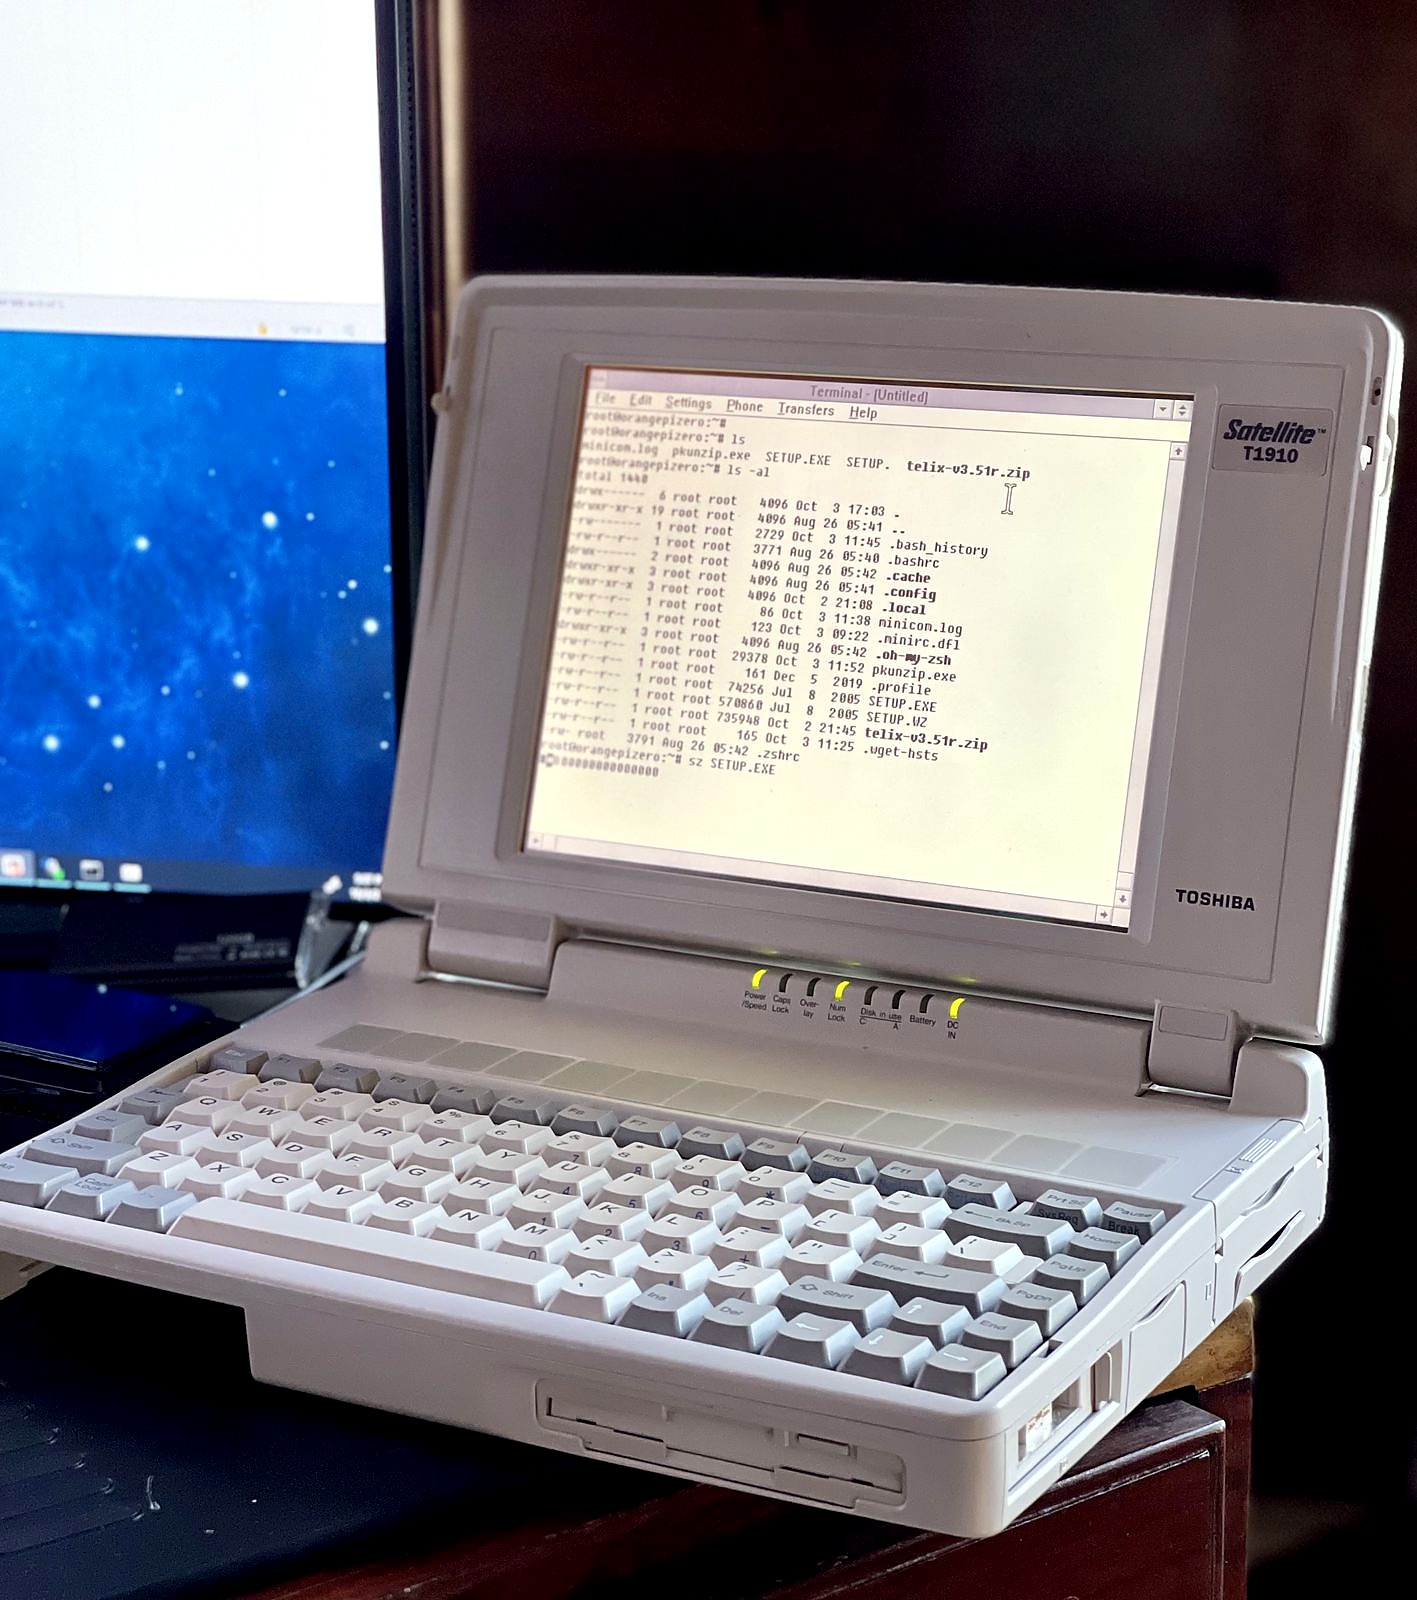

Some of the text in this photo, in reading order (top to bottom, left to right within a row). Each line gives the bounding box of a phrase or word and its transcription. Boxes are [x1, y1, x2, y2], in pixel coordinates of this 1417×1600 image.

[811, 385, 929, 406] Terminal [Untitled]
[594, 392, 878, 422] File Edit Settings Phone Transfers Help
[1223, 419, 1316, 444] Satellite
[731, 434, 745, 445] ls
[671, 445, 751, 460] pkunzip.exe
[765, 451, 831, 466] SETUP.EXE
[845, 456, 888, 470] SETUP.
[1243, 445, 1299, 463] T1910
[727, 464, 741, 475] ls
[749, 466, 771, 477] -al
[759, 497, 885, 517] 4096 Oct 17:03
[757, 512, 883, 532] 4096 Aug 05:41
[754, 528, 988, 558] 2729 Oct 11:45 .bash_history
[752, 543, 939, 569] 3771 Aug 05:40 .bashrc
[750, 558, 930, 584] 4096 Aug 05:42 .cache
[748, 574, 935, 602] 4096 Aug 05:41 .config
[746, 589, 926, 615] 4096 Oct 21:08 .local
[759, 606, 962, 637] 86 Oct 11:38 minicom.log
[750, 620, 961, 651] 123 Oct 09:22 .minirc.dfl
[740, 635, 770, 648] 4096
[777, 639, 799, 653] Aug
[829, 643, 867, 658] 05:42
[731, 650, 956, 682] 29378 Oct 11:52 pkunzip.exe
[743, 667, 931, 696] 161 Dec 2019 .profile
[727, 681, 937, 713] 74256 Jul 2005 SETUP.EXE
[718, 695, 927, 728] 570860 Jul 2005 SETUP.WZ
[716, 711, 760, 726] 735948
[767, 716, 789, 729] Oct
[818, 722, 857, 736] 21:45
[626, 732, 800, 762] 3791 Aug 05:42 .zshrc
[735, 729, 938, 762] 165 Oct 11:25 .wget-hsts
[688, 757, 703, 767] sz
[709, 757, 776, 775] SETUP.EXE
[1175, 888, 1255, 911] TOSHIBA
[744, 991, 767, 1001] Power
[773, 994, 791, 1005] Caps
[741, 1001, 767, 1011] /Speed
[772, 1004, 789, 1014] Lock
[800, 999, 820, 1009] Over-
[829, 1003, 847, 1013] Num
[803, 1009, 814, 1020] lay
[827, 1013, 846, 1023] Lock
[860, 1007, 877, 1017] Disk
[888, 1013, 902, 1021] use
[859, 1017, 866, 1026] C
[909, 1015, 937, 1027] Battery
[947, 1020, 959, 1030] DC
[948, 1031, 957, 1039] IN
[200, 1096, 217, 1106] Q
[258, 1107, 280, 1116] W
[315, 1117, 333, 1126] E
[166, 1123, 182, 1132] A
[374, 1129, 392, 1137] R
[226, 1133, 244, 1143] S
[438, 1139, 454, 1147] T
[285, 1144, 303, 1152] D
[149, 1153, 169, 1161] Z
[345, 1155, 364, 1163] F
[501, 1151, 517, 1159] Y
[209, 1164, 229, 1172] X
[409, 1168, 426, 1177] G
[561, 1163, 579, 1171] U
[271, 1176, 289, 1184] C
[470, 1179, 490, 1189] H
[336, 1187, 353, 1196] V
[534, 1192, 551, 1200] J
[690, 1188, 708, 1196] O
[395, 1199, 414, 1208] B
[600, 1204, 620, 1214] K
[756, 1200, 775, 1208] P
[459, 1211, 480, 1221] N
[1037, 1208, 1079, 1224] SysReq
[1112, 1206, 1153, 1218] Pause
[667, 1216, 679, 1225] L
[524, 1225, 548, 1235] M
[1108, 1221, 1141, 1235] Break
[1084, 1233, 1121, 1245] Home
[871, 1260, 905, 1273] Enter
[822, 1289, 854, 1300] Shift
[719, 1305, 743, 1316] Del
[979, 1319, 1008, 1331] End
